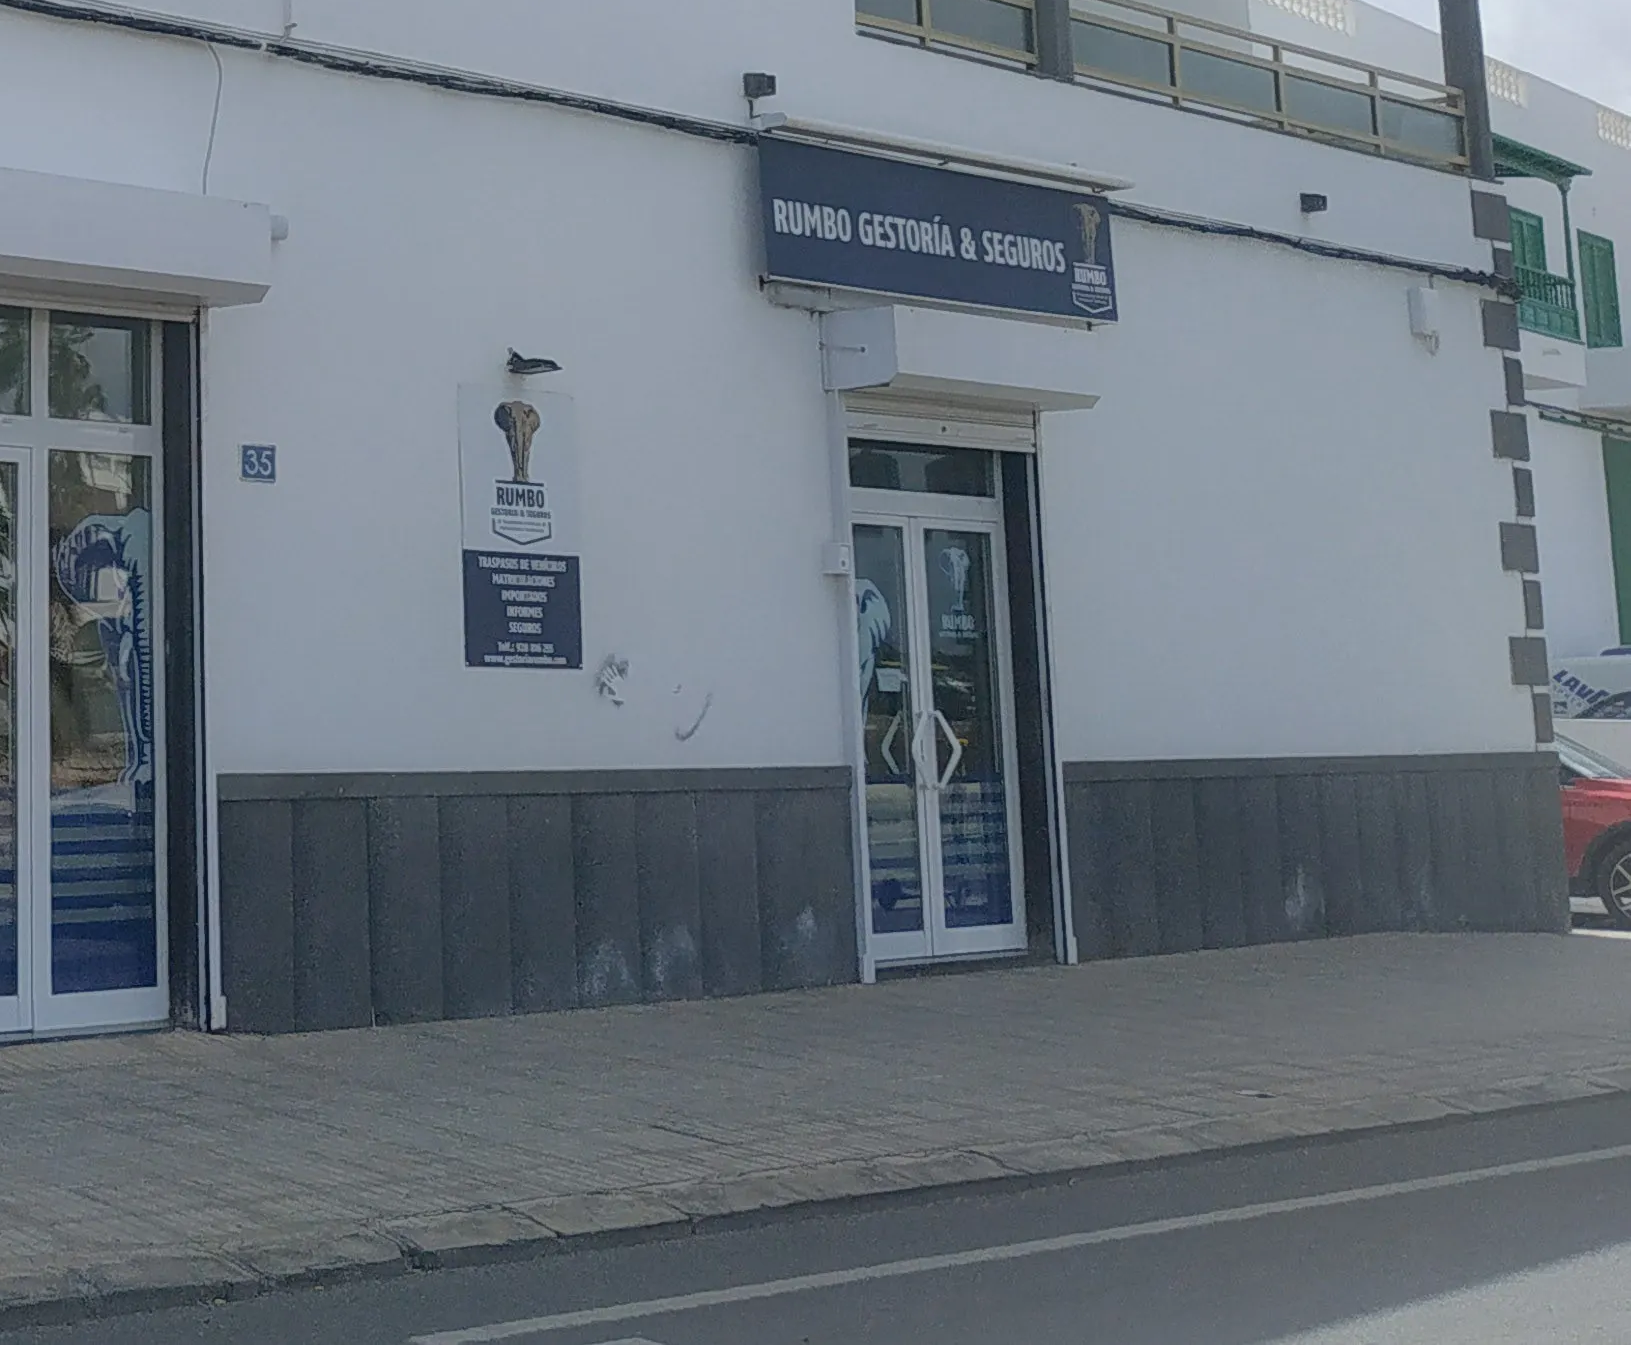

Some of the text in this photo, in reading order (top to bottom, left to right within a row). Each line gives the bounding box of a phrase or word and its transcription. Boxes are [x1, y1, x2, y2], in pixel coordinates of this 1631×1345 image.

[773, 199, 1066, 273] RUMBO GESTORÍA & SEGUROS
[245, 450, 272, 475] 35
[496, 486, 545, 509] RUMBO
[520, 558, 530, 571] DE
[508, 621, 543, 634] SEGUROS
